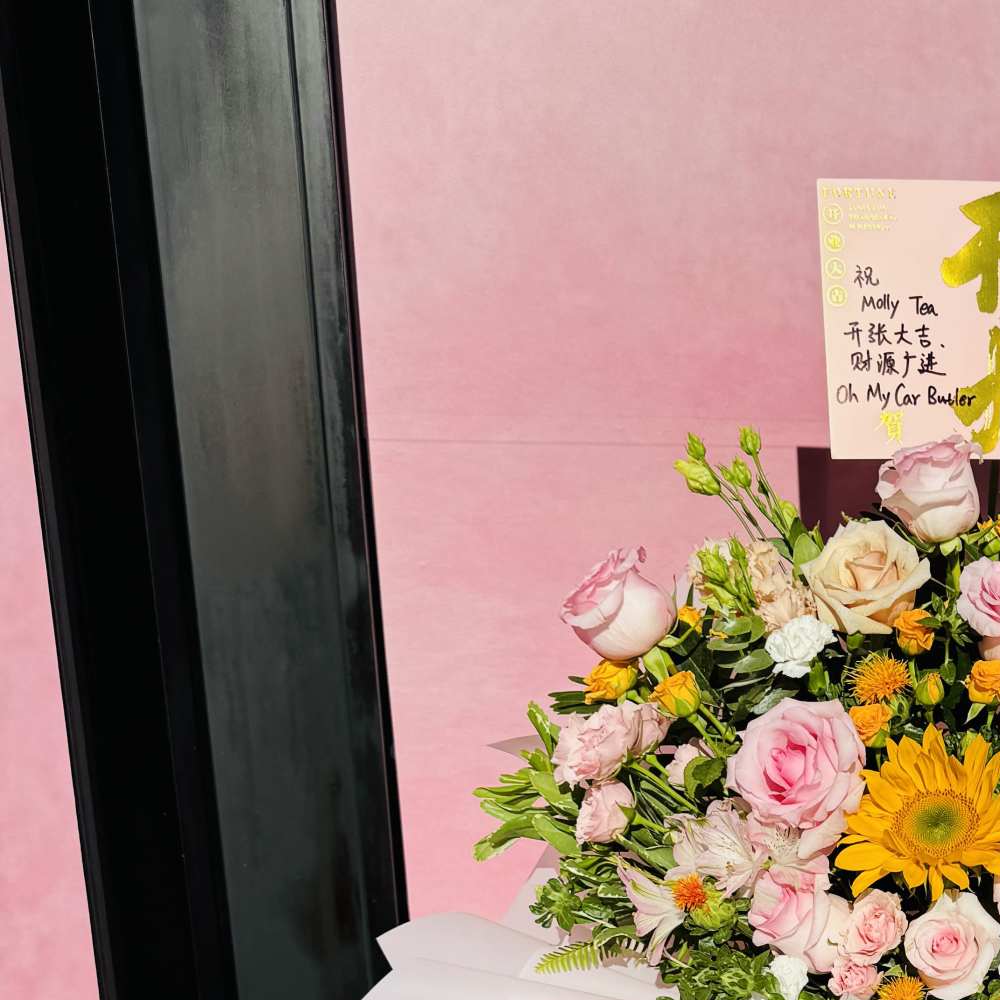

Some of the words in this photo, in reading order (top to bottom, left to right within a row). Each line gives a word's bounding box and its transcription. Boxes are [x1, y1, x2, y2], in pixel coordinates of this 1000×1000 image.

[853, 264, 880, 289] 祝
[861, 293, 900, 320] Molly
[908, 295, 939, 317] Tea
[850, 349, 947, 379] 财源广进
[836, 383, 859, 405] Oh
[866, 381, 891, 411] My
[894, 382, 921, 406] Car
